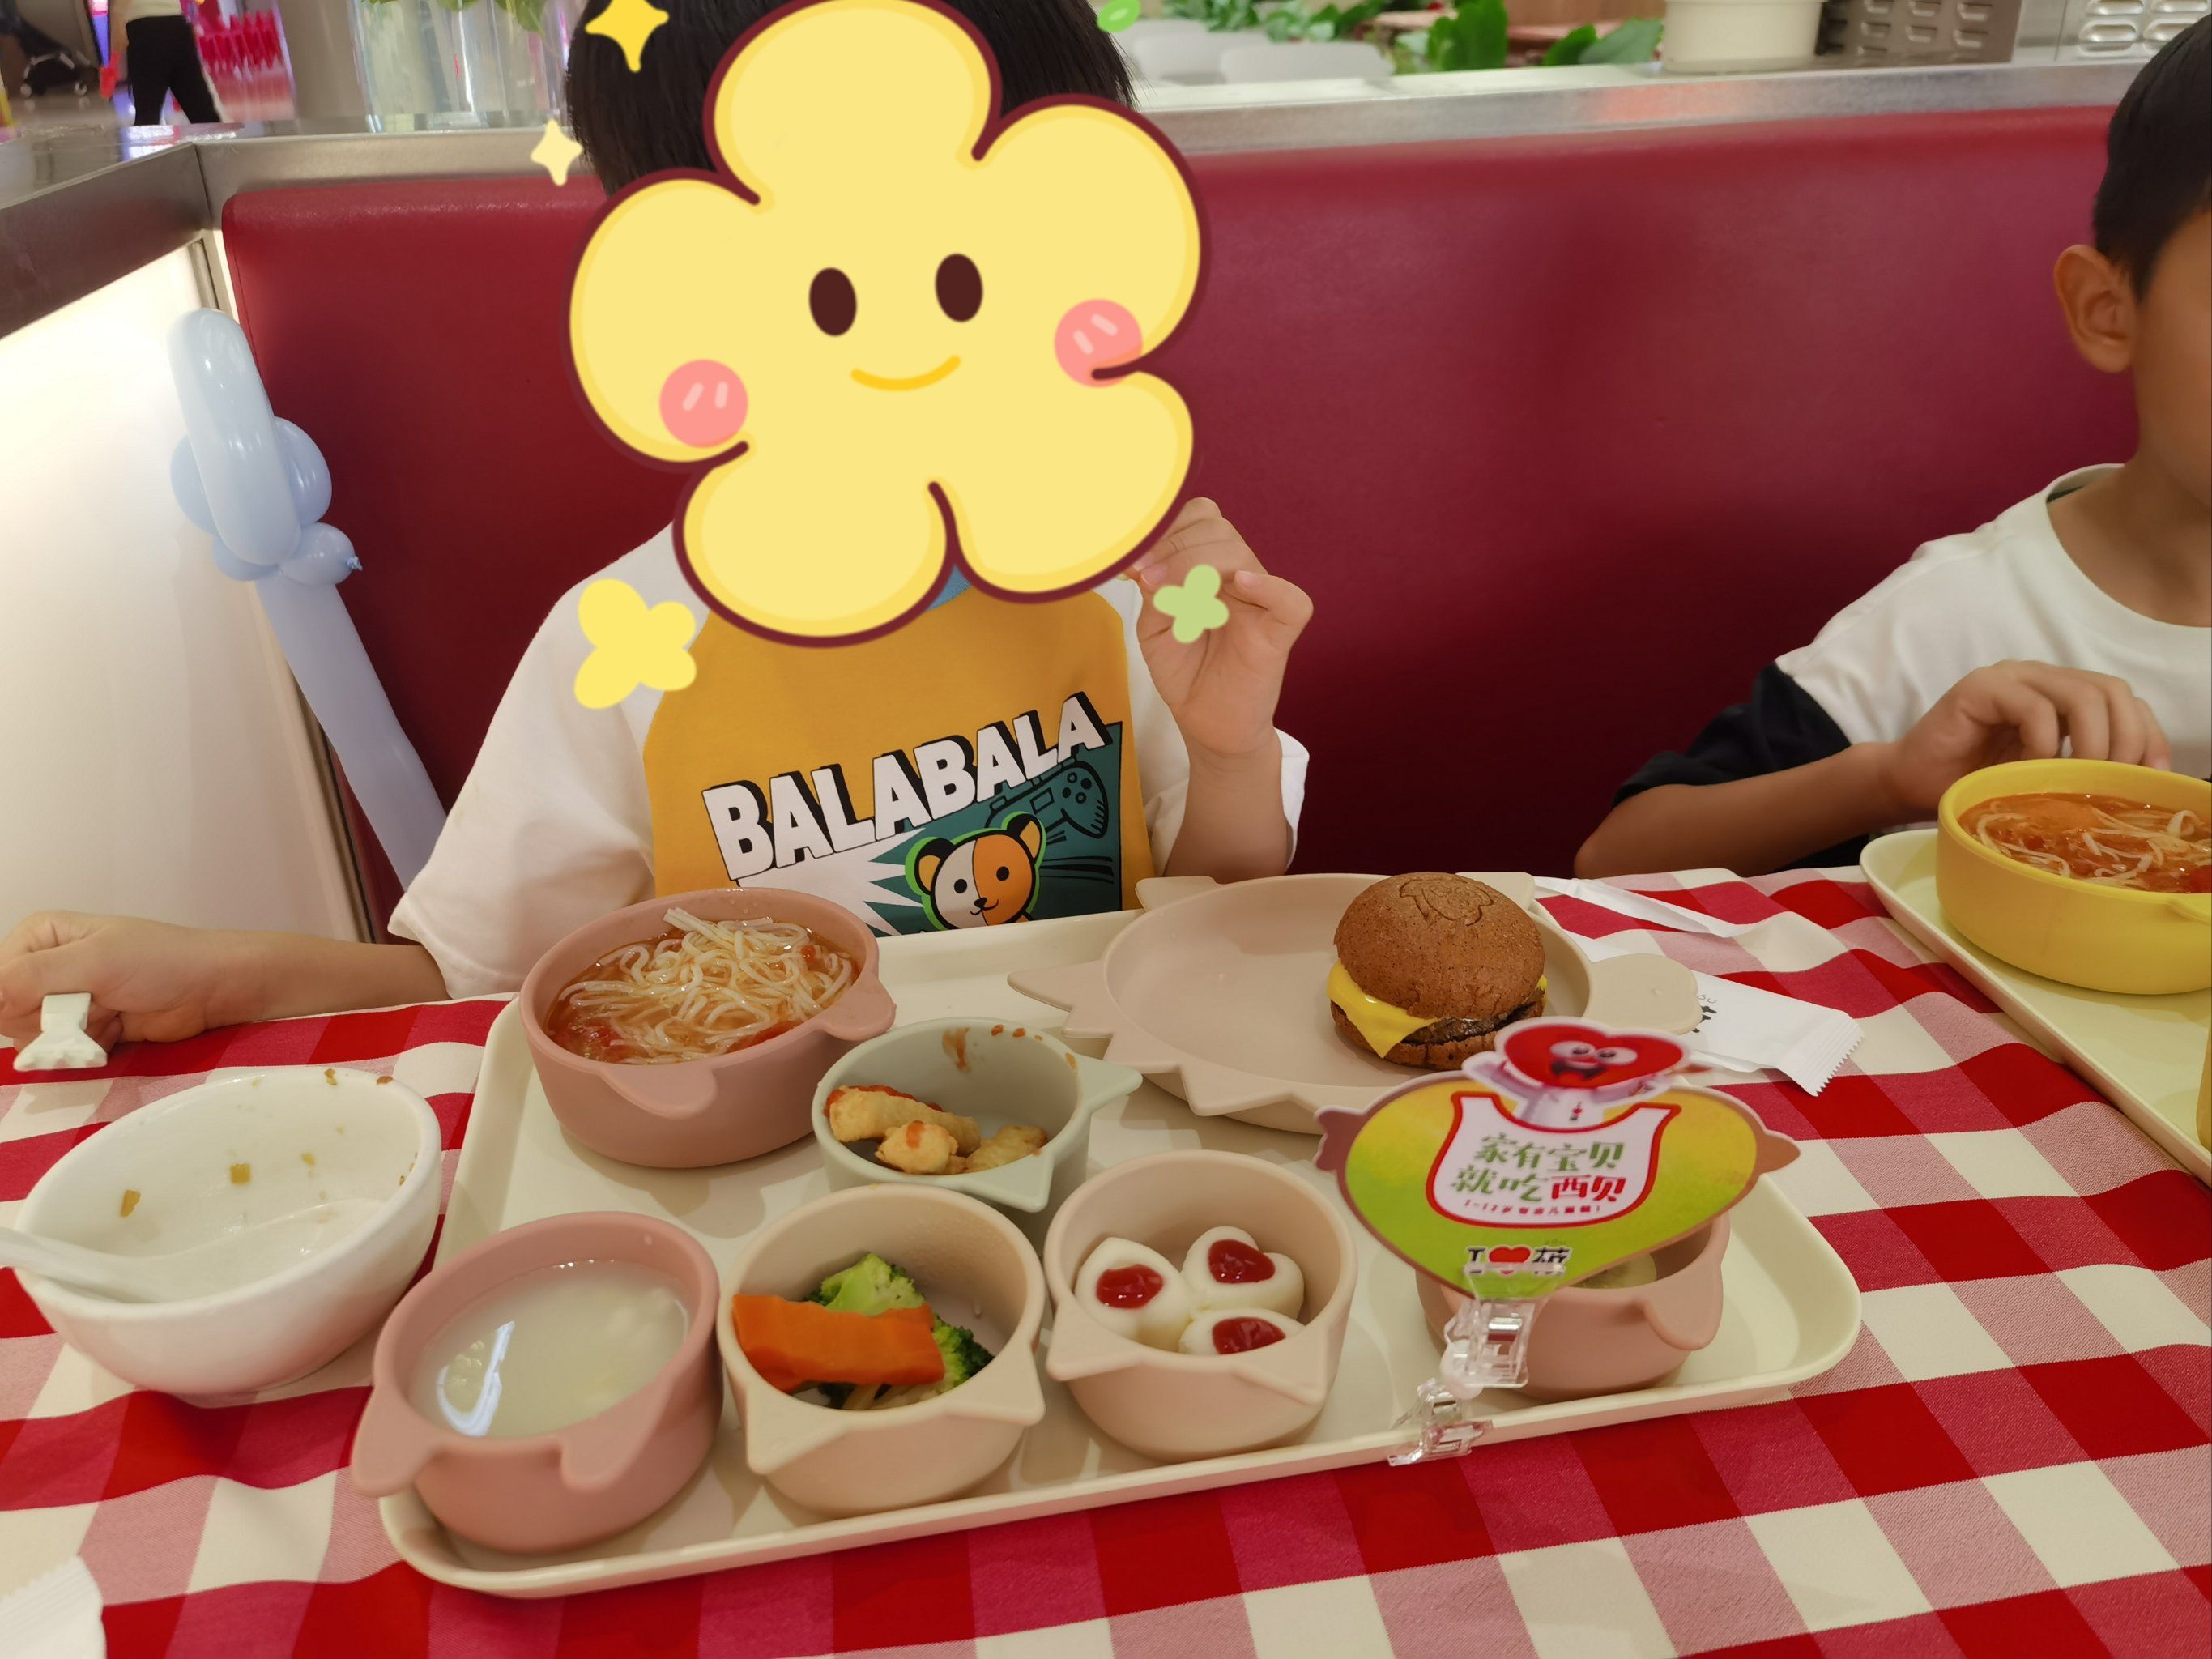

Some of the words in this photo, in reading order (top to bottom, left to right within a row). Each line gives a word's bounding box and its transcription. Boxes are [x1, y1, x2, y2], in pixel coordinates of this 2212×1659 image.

[701, 691, 1114, 881] BALABALA
[1474, 1132, 1625, 1171] 家有宝贝
[1451, 1164, 1627, 1202] 就吃西贝
